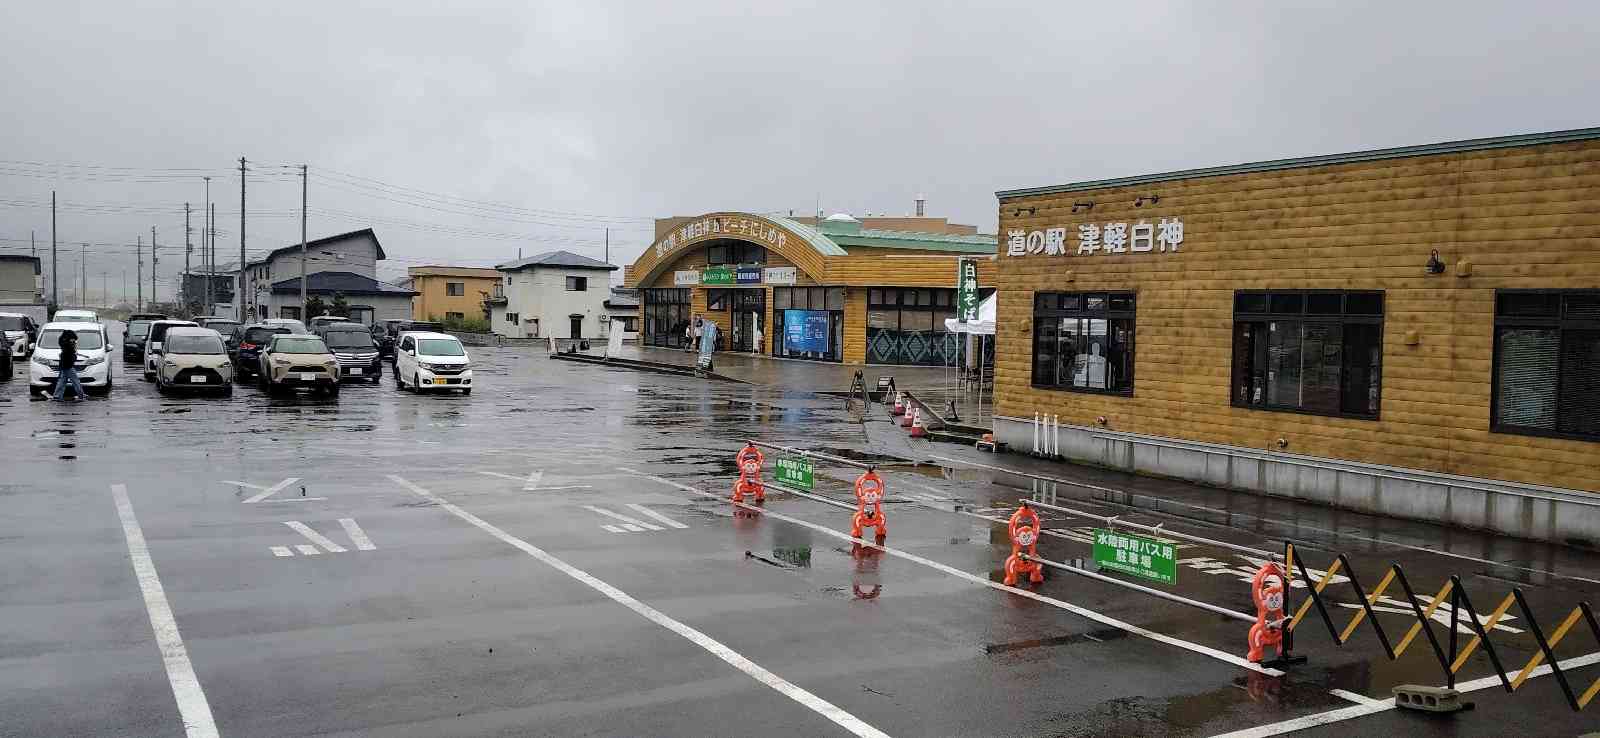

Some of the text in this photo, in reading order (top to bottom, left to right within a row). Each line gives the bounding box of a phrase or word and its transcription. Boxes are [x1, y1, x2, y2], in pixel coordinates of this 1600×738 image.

[1006, 217, 1184, 257] 道の駅 津軽白神
[1097, 531, 1173, 560] 水陸両用バス用
[1115, 548, 1152, 569] 駐車場
